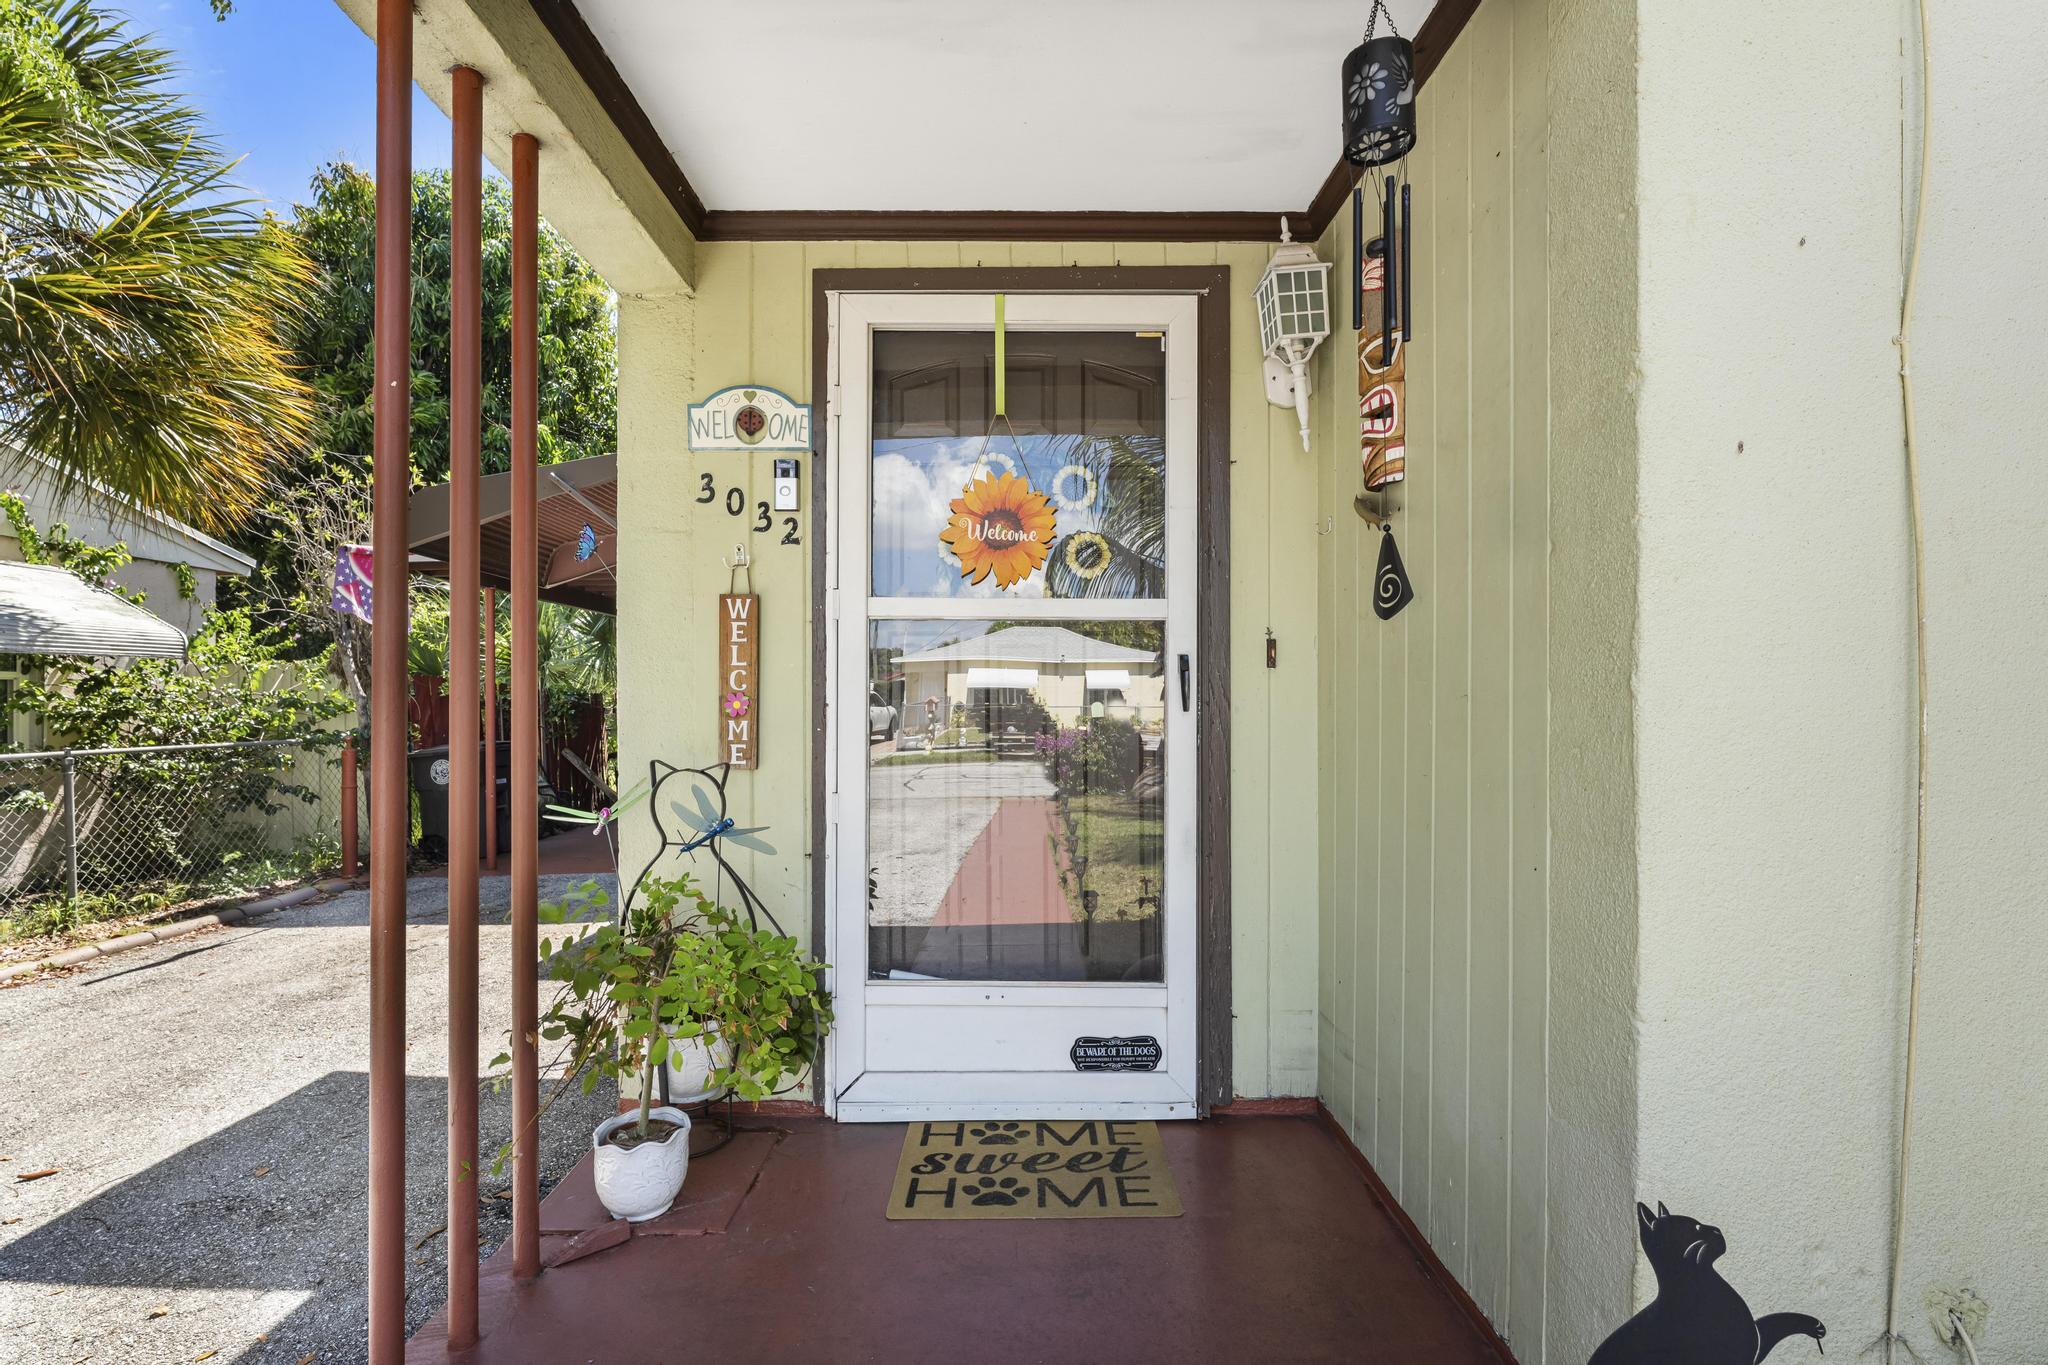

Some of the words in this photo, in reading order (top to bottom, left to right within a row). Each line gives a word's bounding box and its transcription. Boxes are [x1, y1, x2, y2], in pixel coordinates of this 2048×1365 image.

[691, 409, 808, 444] WELOME
[695, 472, 802, 545] 3032
[959, 517, 1039, 542] Welcome
[726, 598, 752, 765] WELCME
[1076, 1047, 1107, 1056] BEWARE
[1108, 1047, 1117, 1056] OF
[1119, 1046, 1134, 1055] THE
[1134, 1046, 1156, 1055] DOGS
[919, 1121, 1142, 1147] HME
[911, 1147, 1148, 1175] sweet
[904, 1176, 1158, 1208] HME
